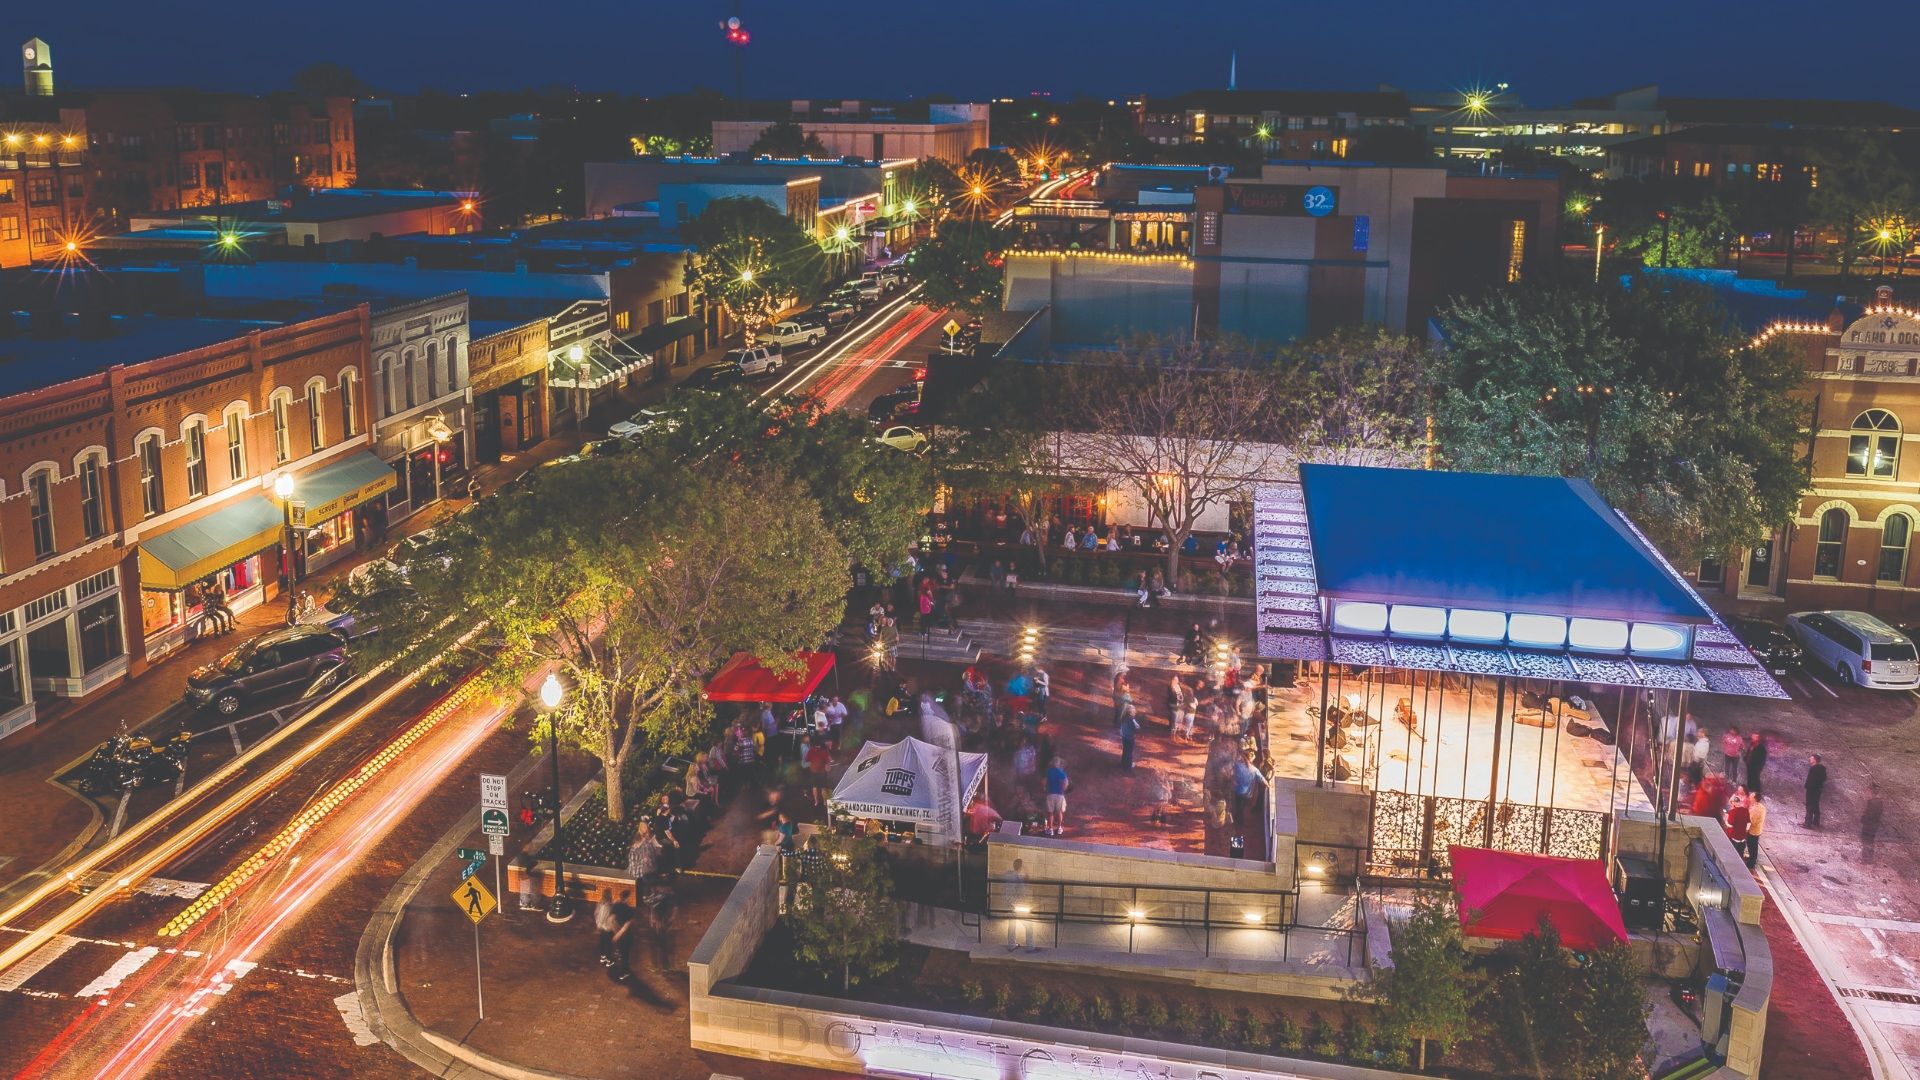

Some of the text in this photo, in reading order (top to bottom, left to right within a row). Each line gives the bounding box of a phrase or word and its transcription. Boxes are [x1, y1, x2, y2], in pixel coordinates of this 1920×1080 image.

[1304, 194, 1326, 209] 32
[1851, 330, 1887, 343] PLANO
[318, 479, 387, 516] SCRUBS UNIFORMS
[885, 772, 915, 788] TUPPS
[844, 803, 883, 814] HANDCRAFTED
[884, 806, 891, 814] IN
[458, 849, 465, 859] J
[462, 870, 468, 880] E
